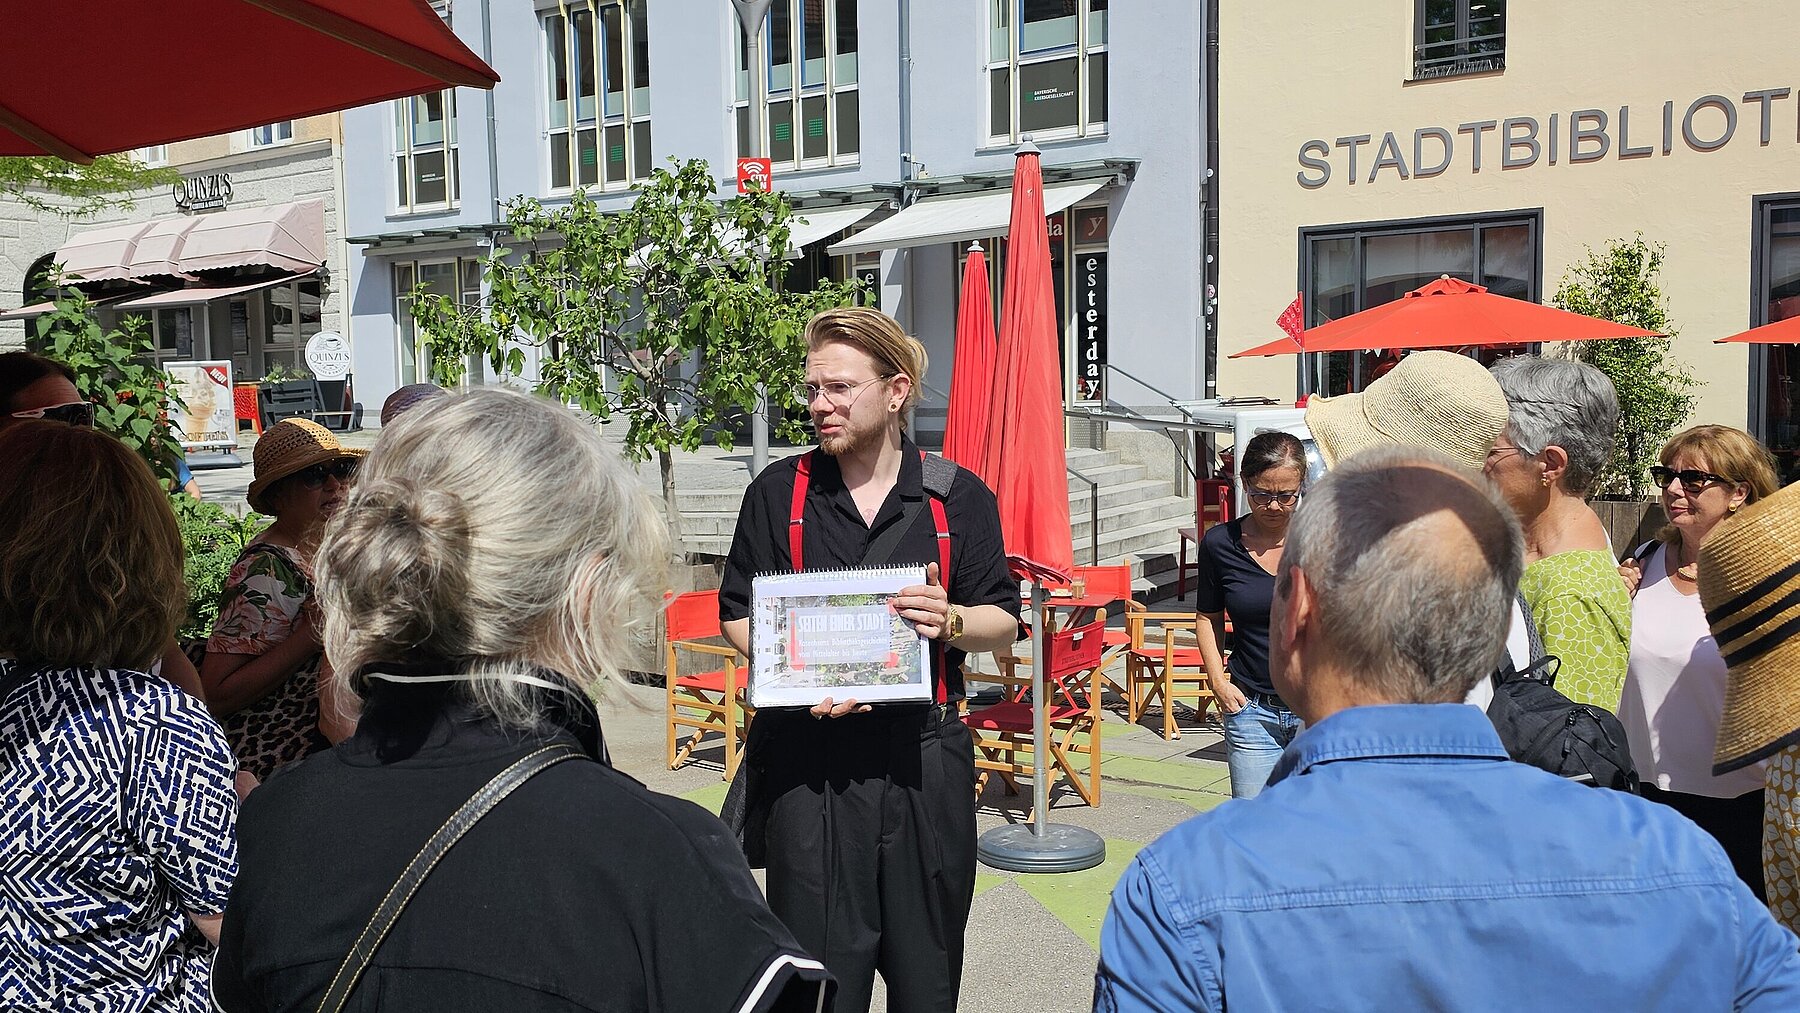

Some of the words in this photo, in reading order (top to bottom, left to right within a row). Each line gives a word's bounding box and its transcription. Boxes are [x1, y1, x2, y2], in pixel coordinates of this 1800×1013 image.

[1297, 87, 1800, 190] STADTBIBLIOT
[750, 174, 768, 182] CITY
[209, 368, 227, 384] NEU!
[798, 615, 827, 632] SEITEN
[829, 613, 855, 631] EINER
[857, 612, 885, 631] STADT
